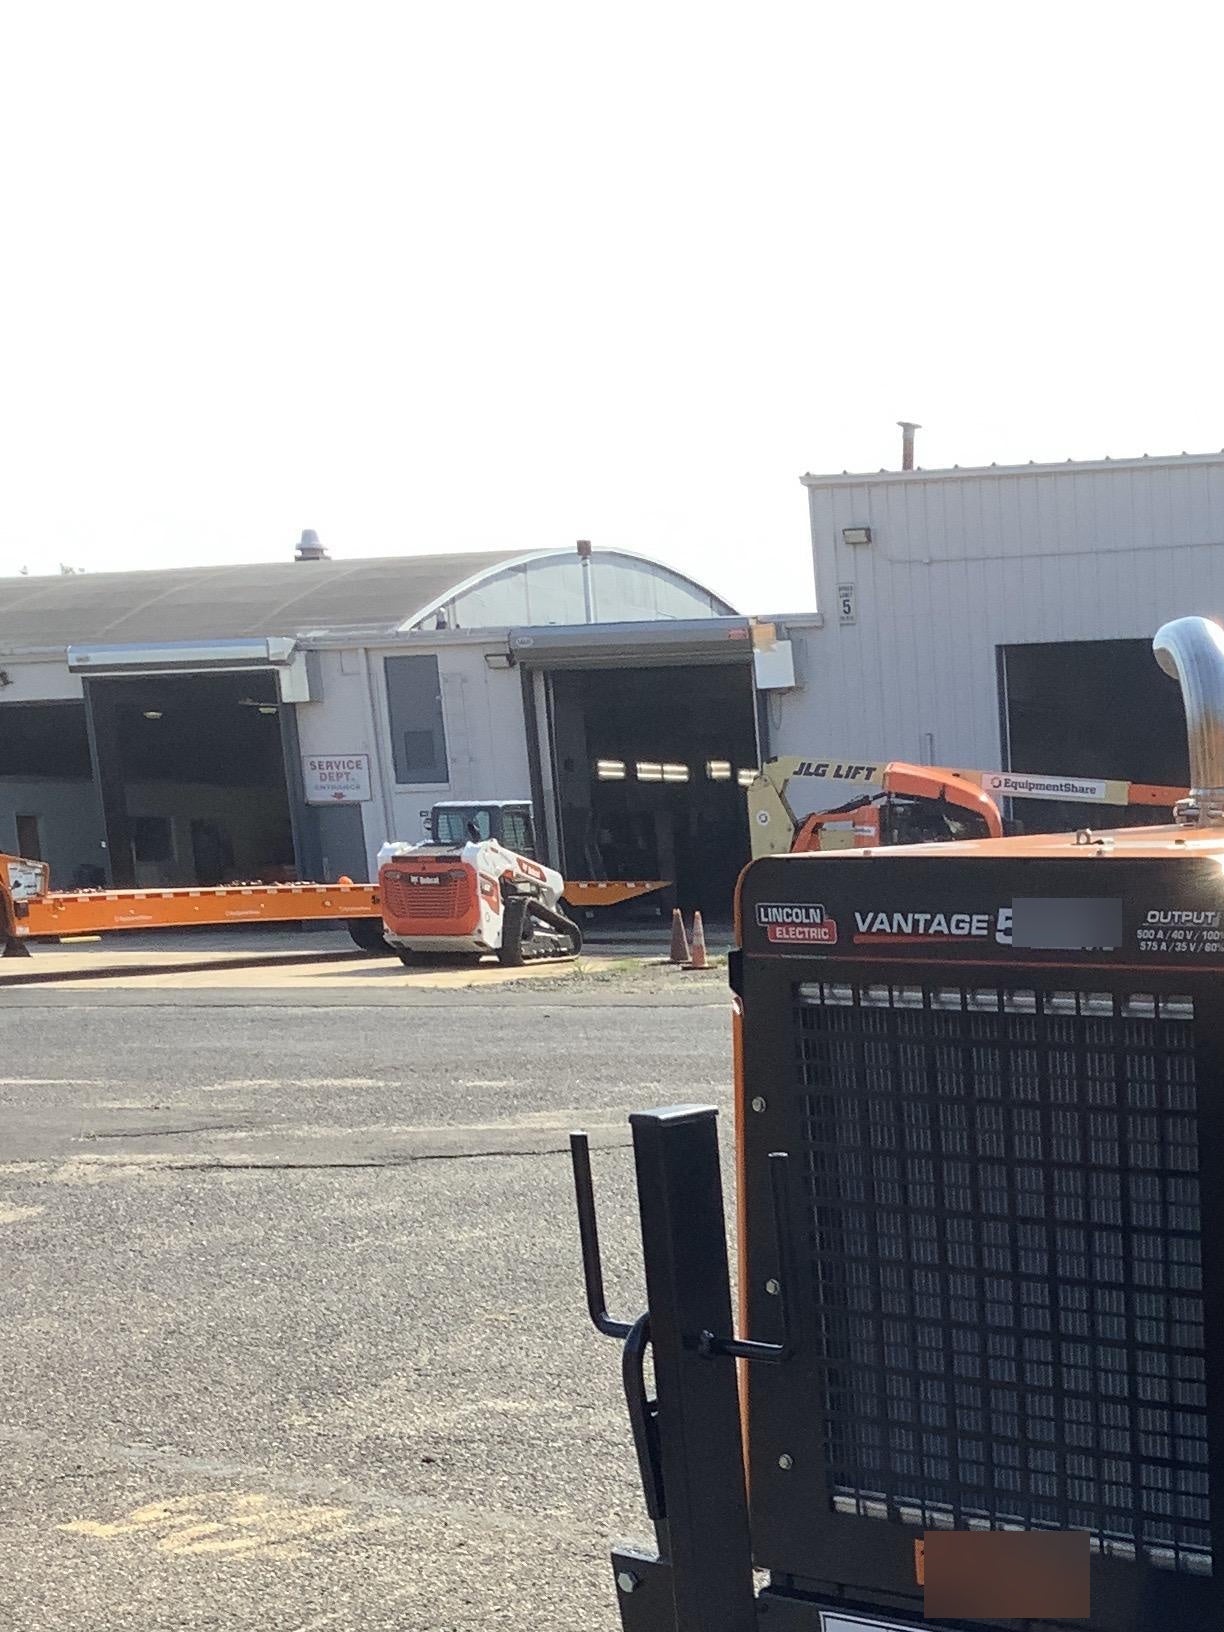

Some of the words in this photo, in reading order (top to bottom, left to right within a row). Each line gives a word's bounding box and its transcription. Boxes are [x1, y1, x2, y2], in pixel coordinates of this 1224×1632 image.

[309, 760, 363, 771] SERVICE
[793, 761, 829, 777] JLG
[833, 764, 877, 780] LIFT
[319, 771, 356, 782] DEPT.
[1003, 777, 1097, 795] EquipmentShare
[759, 906, 822, 924] LINCOLN
[1146, 910, 1216, 924] OUTPUT
[854, 911, 989, 936] VANTAGE
[775, 928, 830, 940] ELECTRIC
